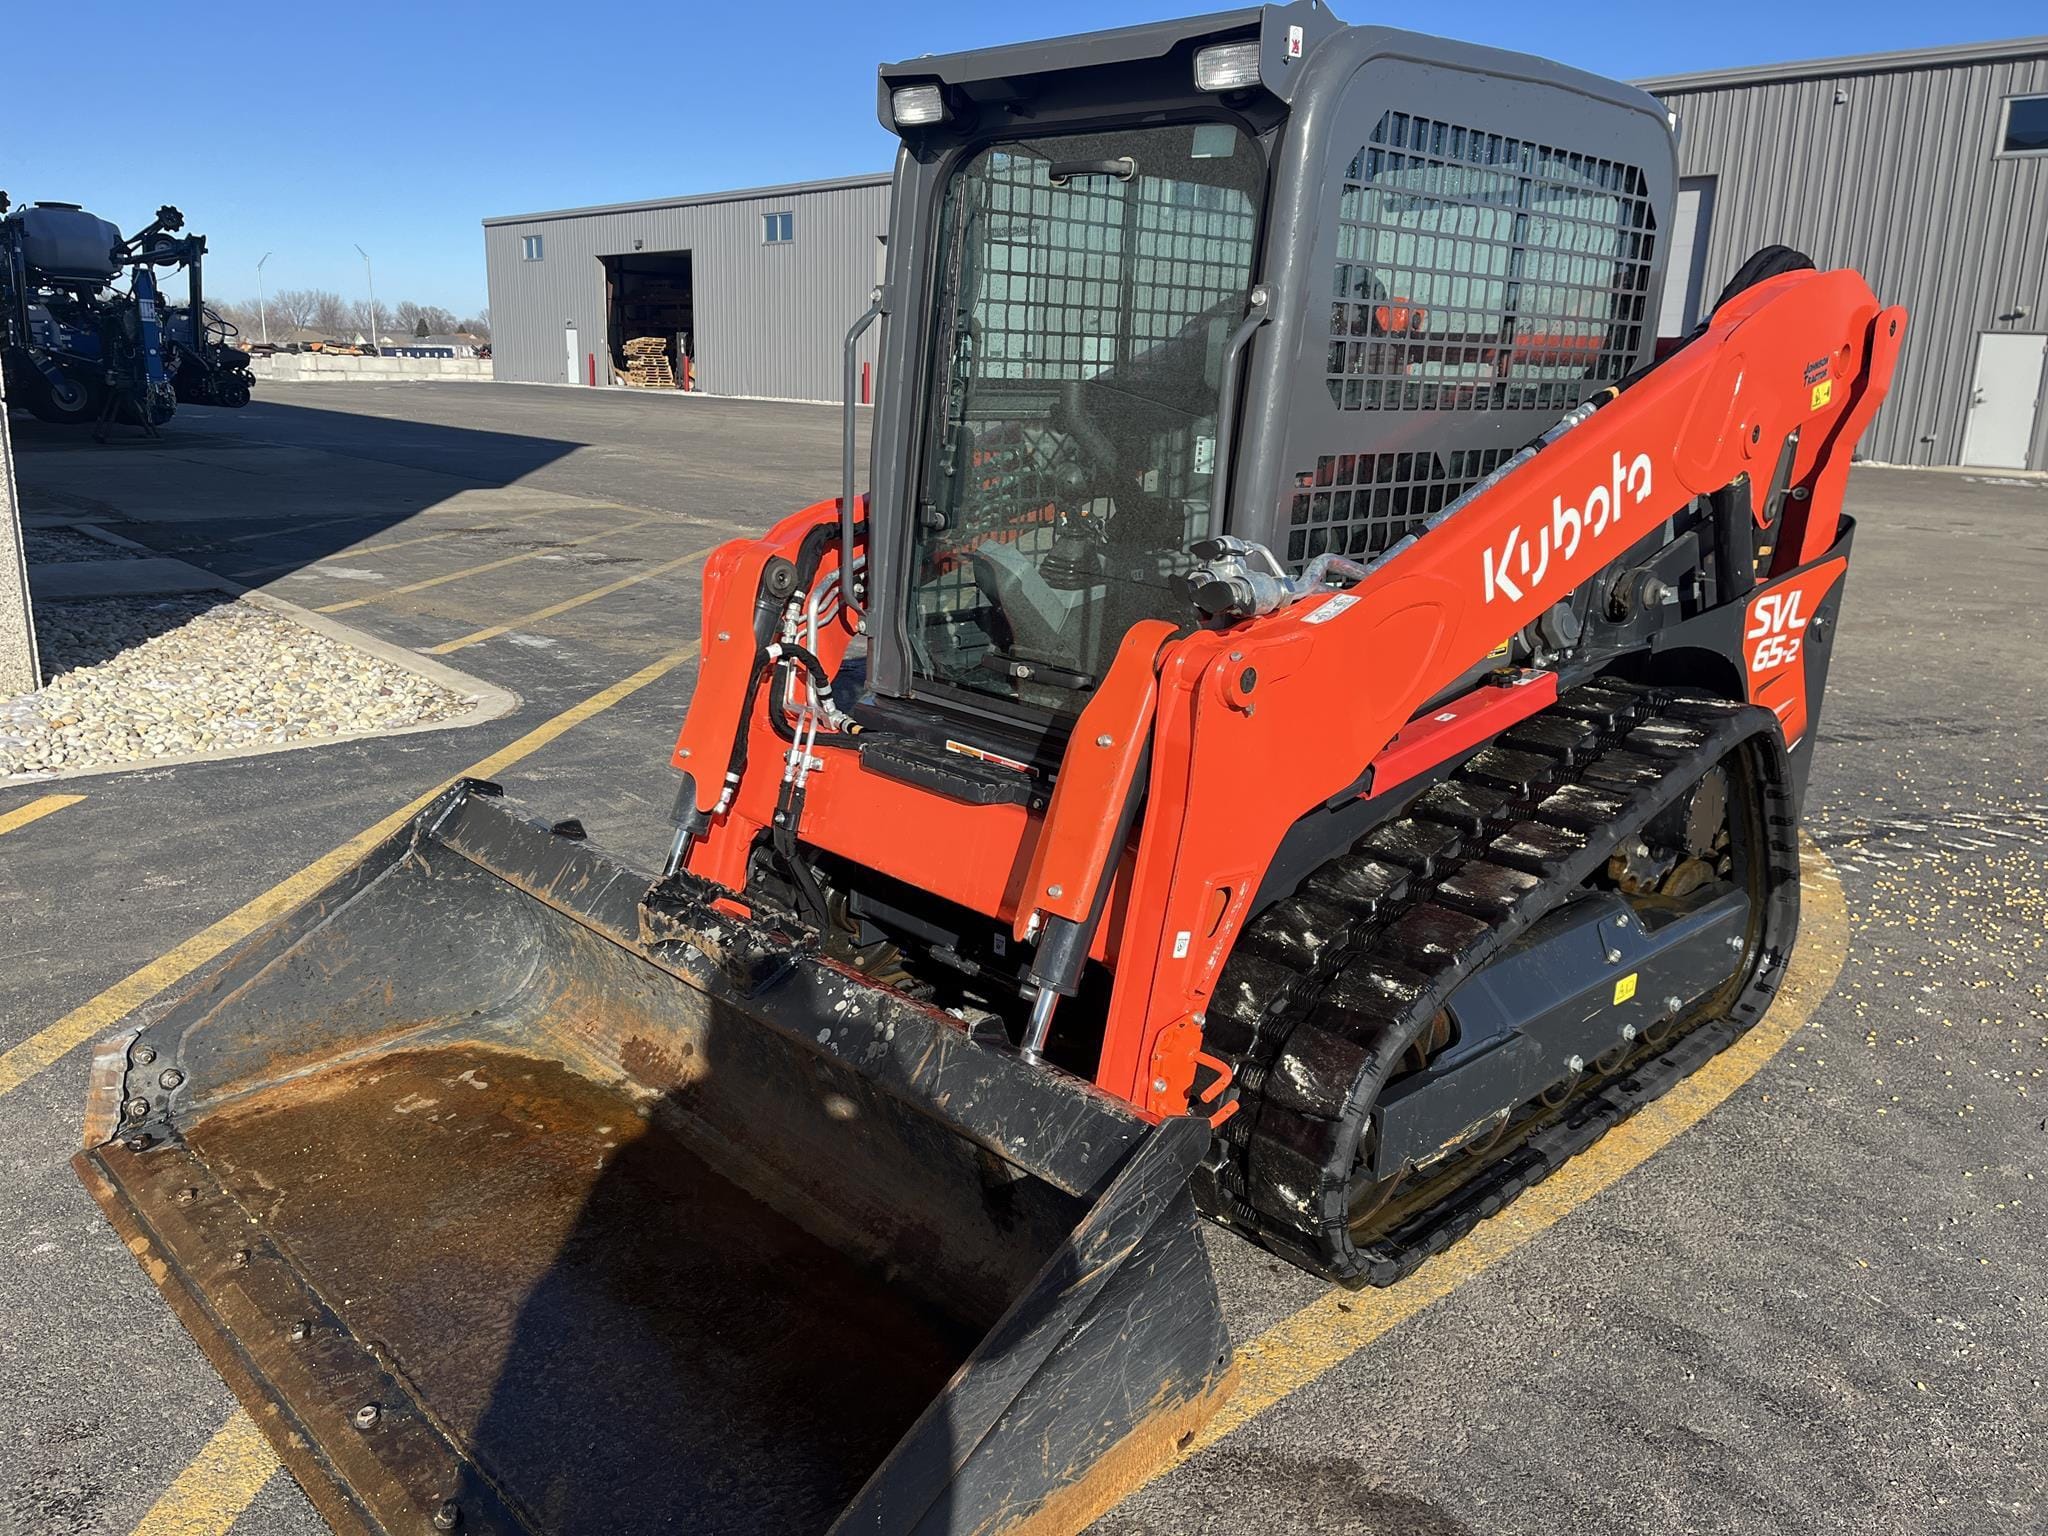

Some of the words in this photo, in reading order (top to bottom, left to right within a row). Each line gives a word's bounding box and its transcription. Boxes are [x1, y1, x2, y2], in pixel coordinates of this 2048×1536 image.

[1483, 450, 1653, 604] Kubota
[1747, 590, 1807, 640] SVL
[1752, 634, 1801, 673] 65-2
